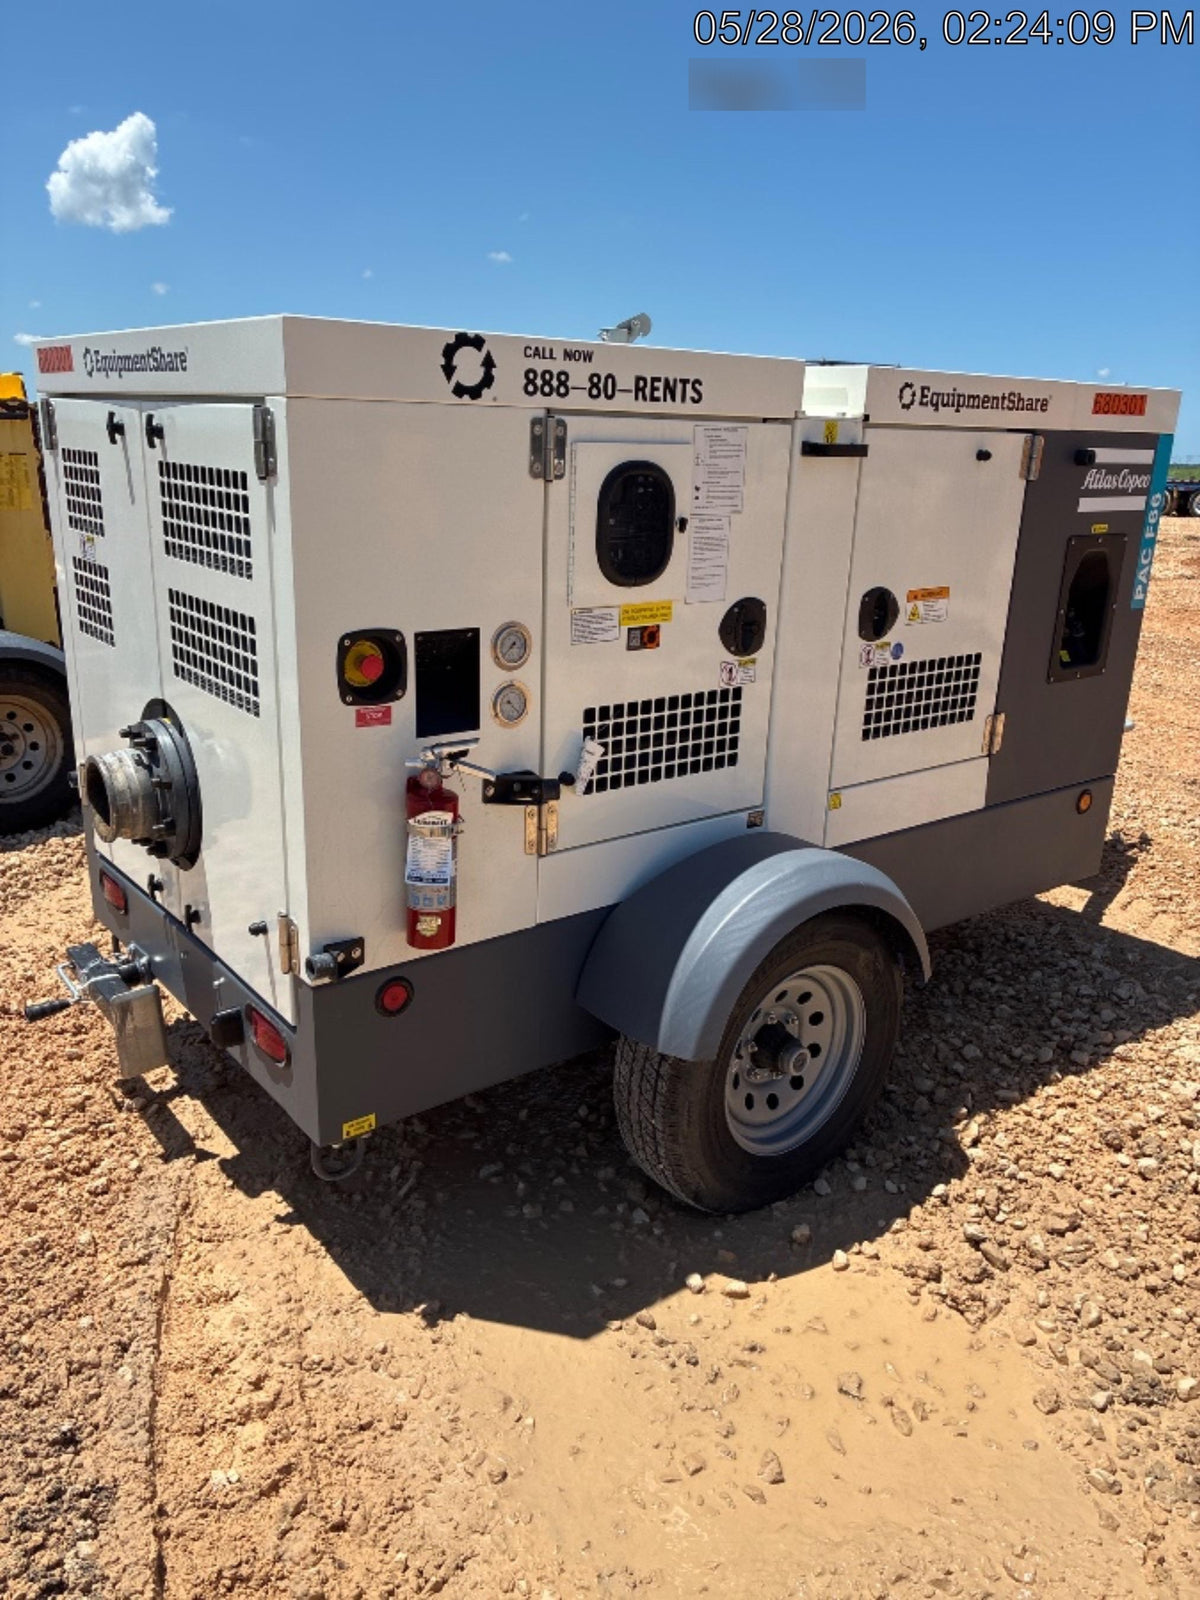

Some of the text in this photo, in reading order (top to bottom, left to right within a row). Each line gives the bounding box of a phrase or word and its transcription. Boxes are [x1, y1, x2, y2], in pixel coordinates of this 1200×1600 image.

[94, 346, 188, 378] EquipmentShare
[523, 346, 594, 363] CALL NOW
[919, 385, 1049, 413] EquipmentShare
[1133, 549, 1151, 601] PAC
